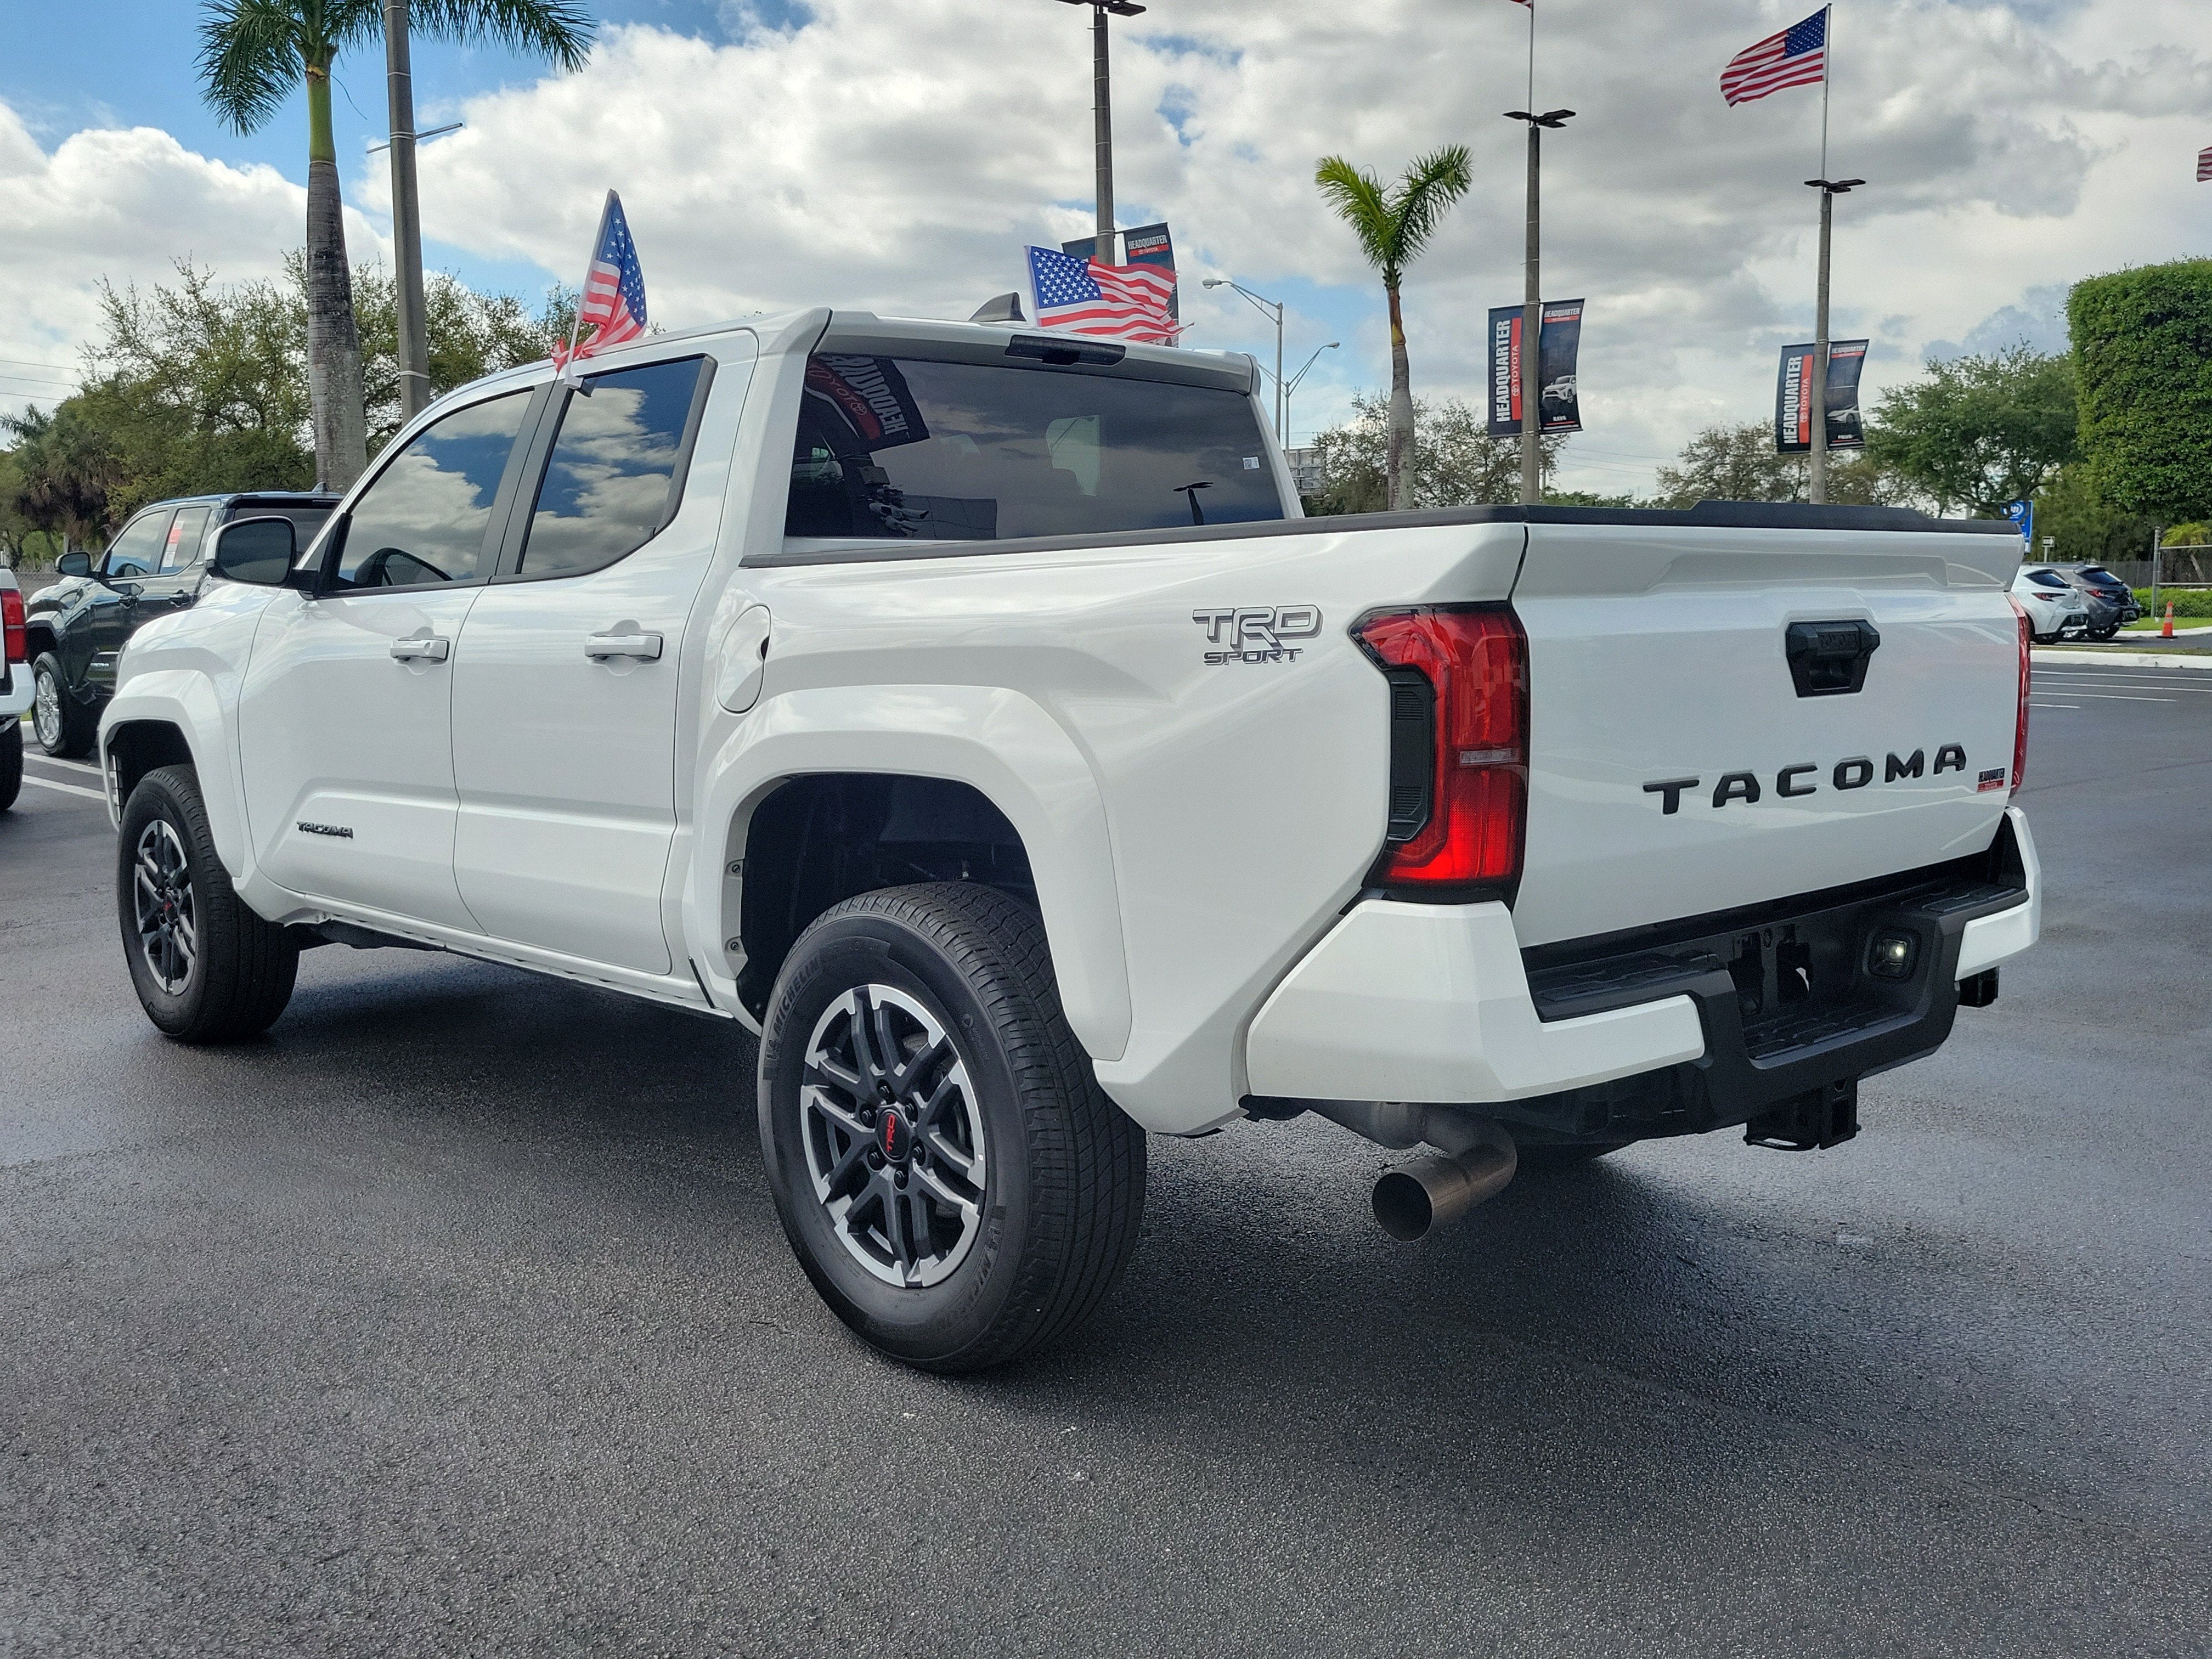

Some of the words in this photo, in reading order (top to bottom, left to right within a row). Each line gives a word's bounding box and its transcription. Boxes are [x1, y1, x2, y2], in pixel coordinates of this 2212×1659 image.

[1128, 235, 1167, 250] HEADQUARTER
[1544, 308, 1580, 318] HEADQUARTER
[1496, 319, 1511, 422] HEADQUARTER
[1783, 356, 1802, 444] HEADQUARTER
[1801, 378, 1809, 410] TOYOTA
[1193, 604, 1323, 651] TRD
[1204, 648, 1304, 666] SPORT
[1643, 743, 1966, 815] TACOMA
[297, 821, 353, 839] TACOMA
[772, 957, 820, 1037] MICHELIN
[886, 1114, 895, 1152] TRD
